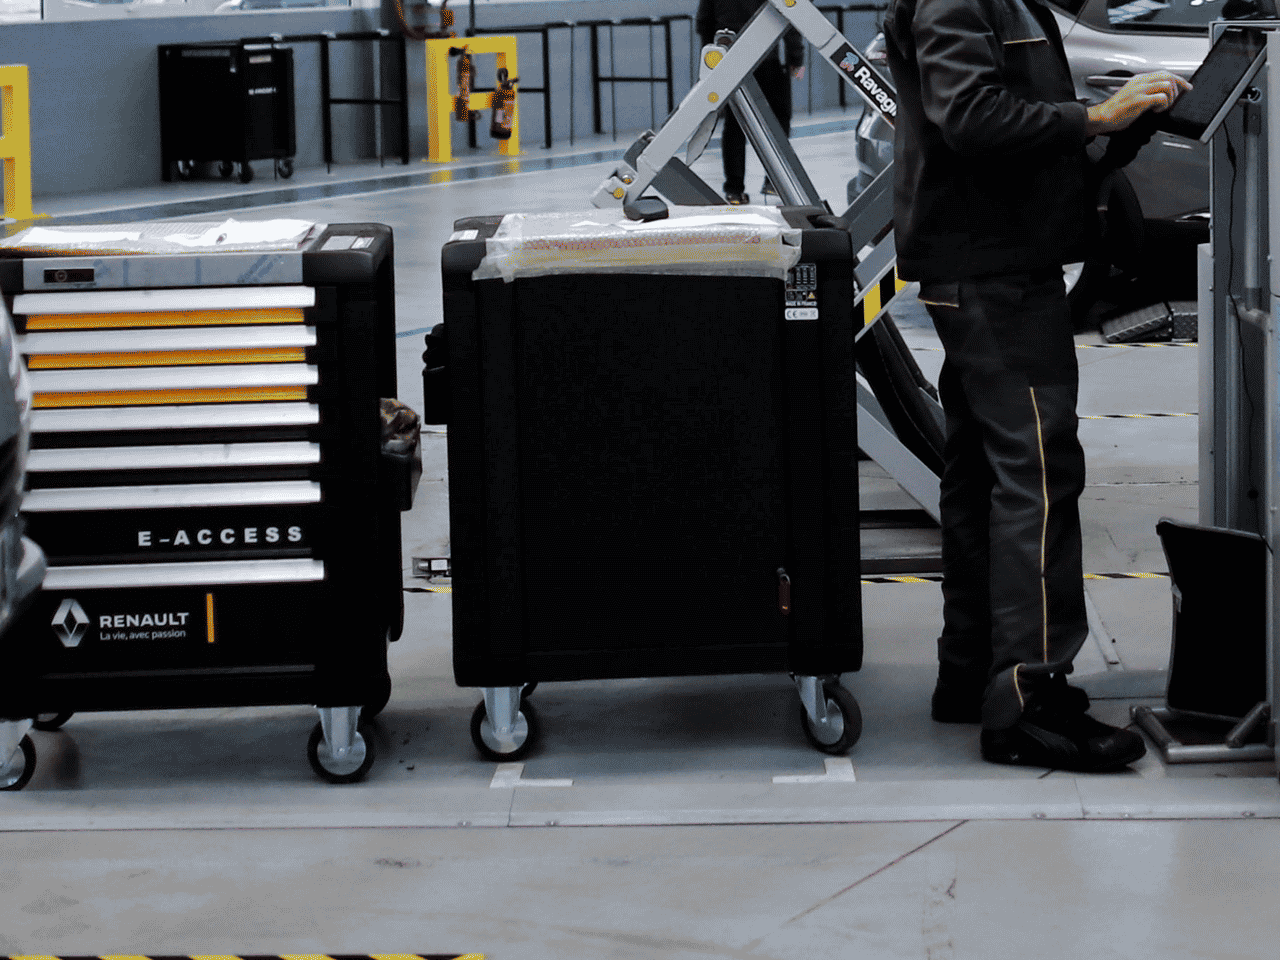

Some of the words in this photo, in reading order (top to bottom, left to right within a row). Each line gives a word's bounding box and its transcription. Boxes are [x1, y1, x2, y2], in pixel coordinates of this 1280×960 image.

[137, 526, 303, 547] E-ACCESS
[99, 612, 190, 629] RENAULT
[99, 631, 111, 641] La
[112, 630, 128, 641] vie,
[129, 631, 151, 639] avec
[152, 629, 186, 641] passion
